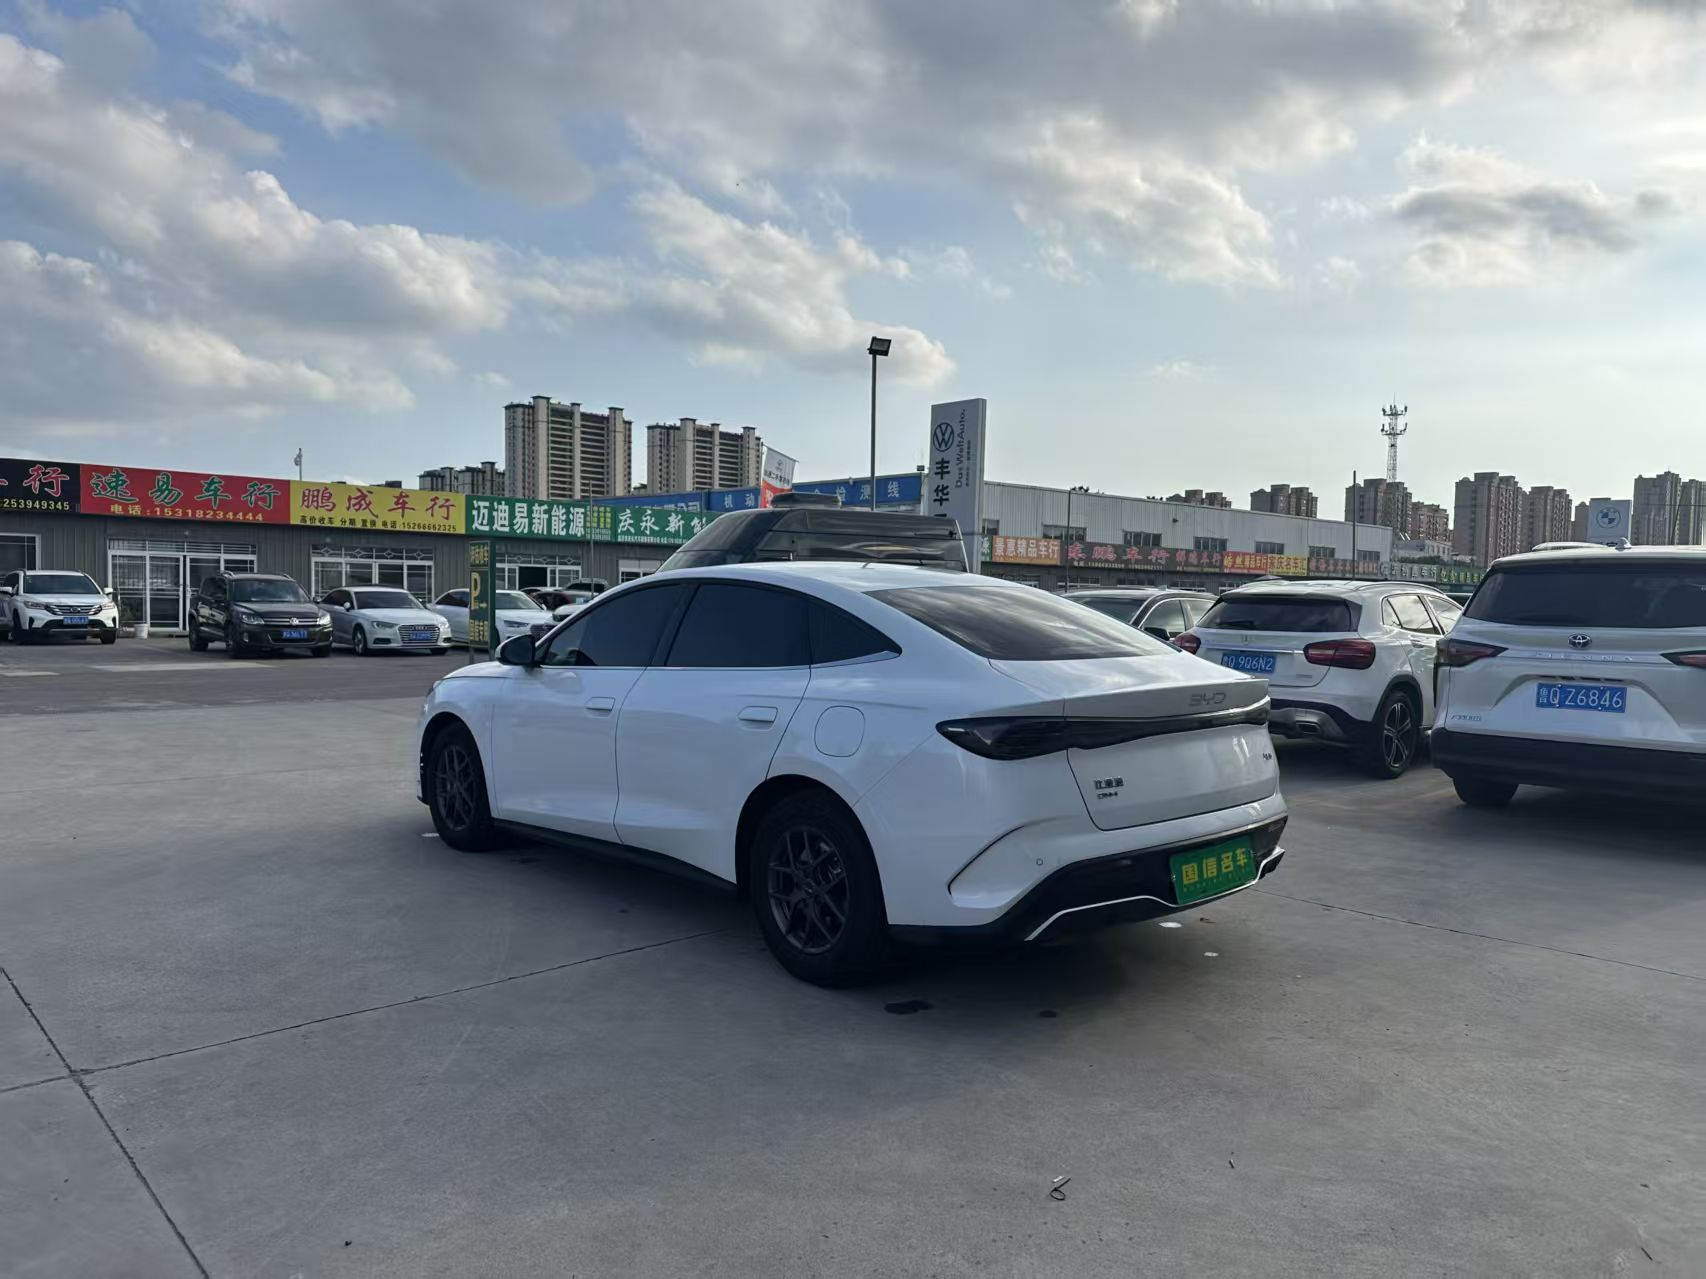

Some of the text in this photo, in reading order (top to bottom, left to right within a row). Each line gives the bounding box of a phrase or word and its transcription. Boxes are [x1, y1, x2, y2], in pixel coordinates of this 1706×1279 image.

[90, 468, 281, 510] 速易车行
[300, 486, 456, 521] 鹏成车行
[471, 500, 585, 537] 迈迪易新能源
[1188, 692, 1226, 707] BYD
[1182, 848, 1248, 885] 国信名车
